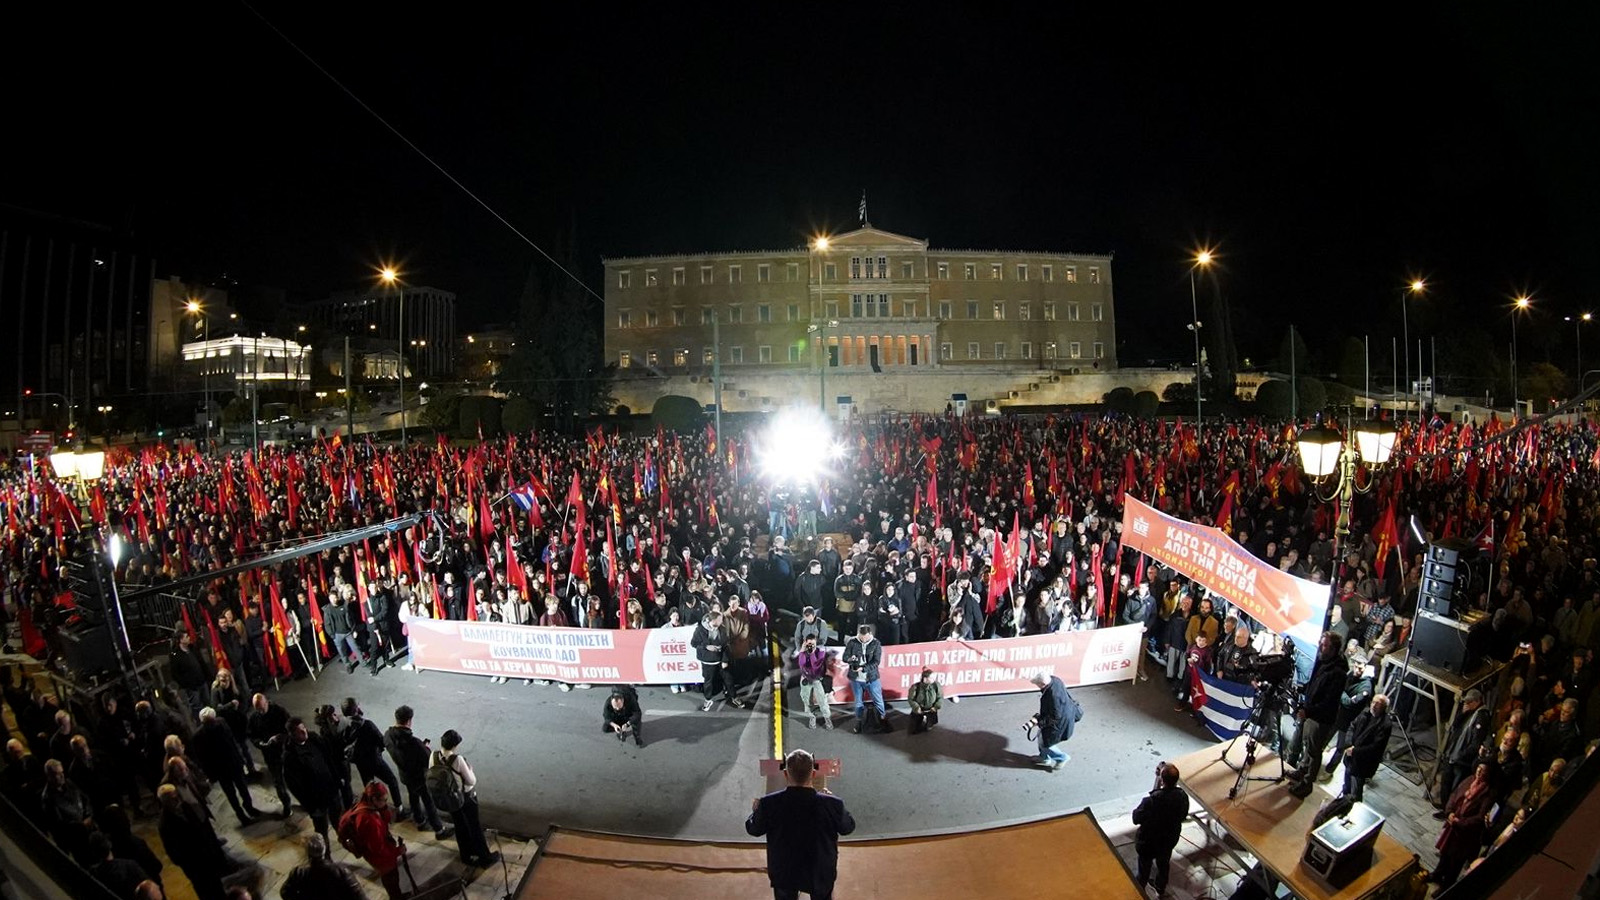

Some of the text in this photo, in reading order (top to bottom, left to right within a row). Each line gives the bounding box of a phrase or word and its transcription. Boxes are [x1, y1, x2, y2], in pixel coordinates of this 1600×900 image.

[1166, 526, 1199, 550] ΚΑΤΩ
[1202, 541, 1216, 560] ΤΑ
[1220, 550, 1257, 583] ΧΕΡΙΑ
[1164, 539, 1189, 558] ΑΠΟ
[1192, 550, 1214, 572] ΤΗΝ
[1216, 563, 1256, 596] ΚΟΥΒΑ
[463, 627, 609, 646] ΑΛΛΗΛΕΓΓΥΗ ΣΤΟΝ ΑΓΩΝΙΣΤΗ
[493, 645, 576, 662] ΚΟΥΒΑΝΙΚΟ ΛΑΟ
[660, 643, 687, 654] ΚΚΕ
[888, 642, 1073, 667] ΚΑΤΩ ΤΑ ΧΕΡΙΑ ΑΠΟ ΤΗΝ ΚΟΥΒΑ
[460, 659, 620, 679] ΚΑΤΩ ΤΑ ΧΕΡΙΑ ΑΠΟ ΤΗΝ ΚΟΥΒΑ
[657, 661, 685, 672] ΚΝΕ
[1093, 660, 1119, 673] ΚΝΕ
[901, 674, 910, 688] Η
[913, 672, 954, 687] ΚΥΒΑ
[956, 669, 981, 684] ΔΕΝ
[984, 667, 1016, 682] ΕΙΝΑΙ
